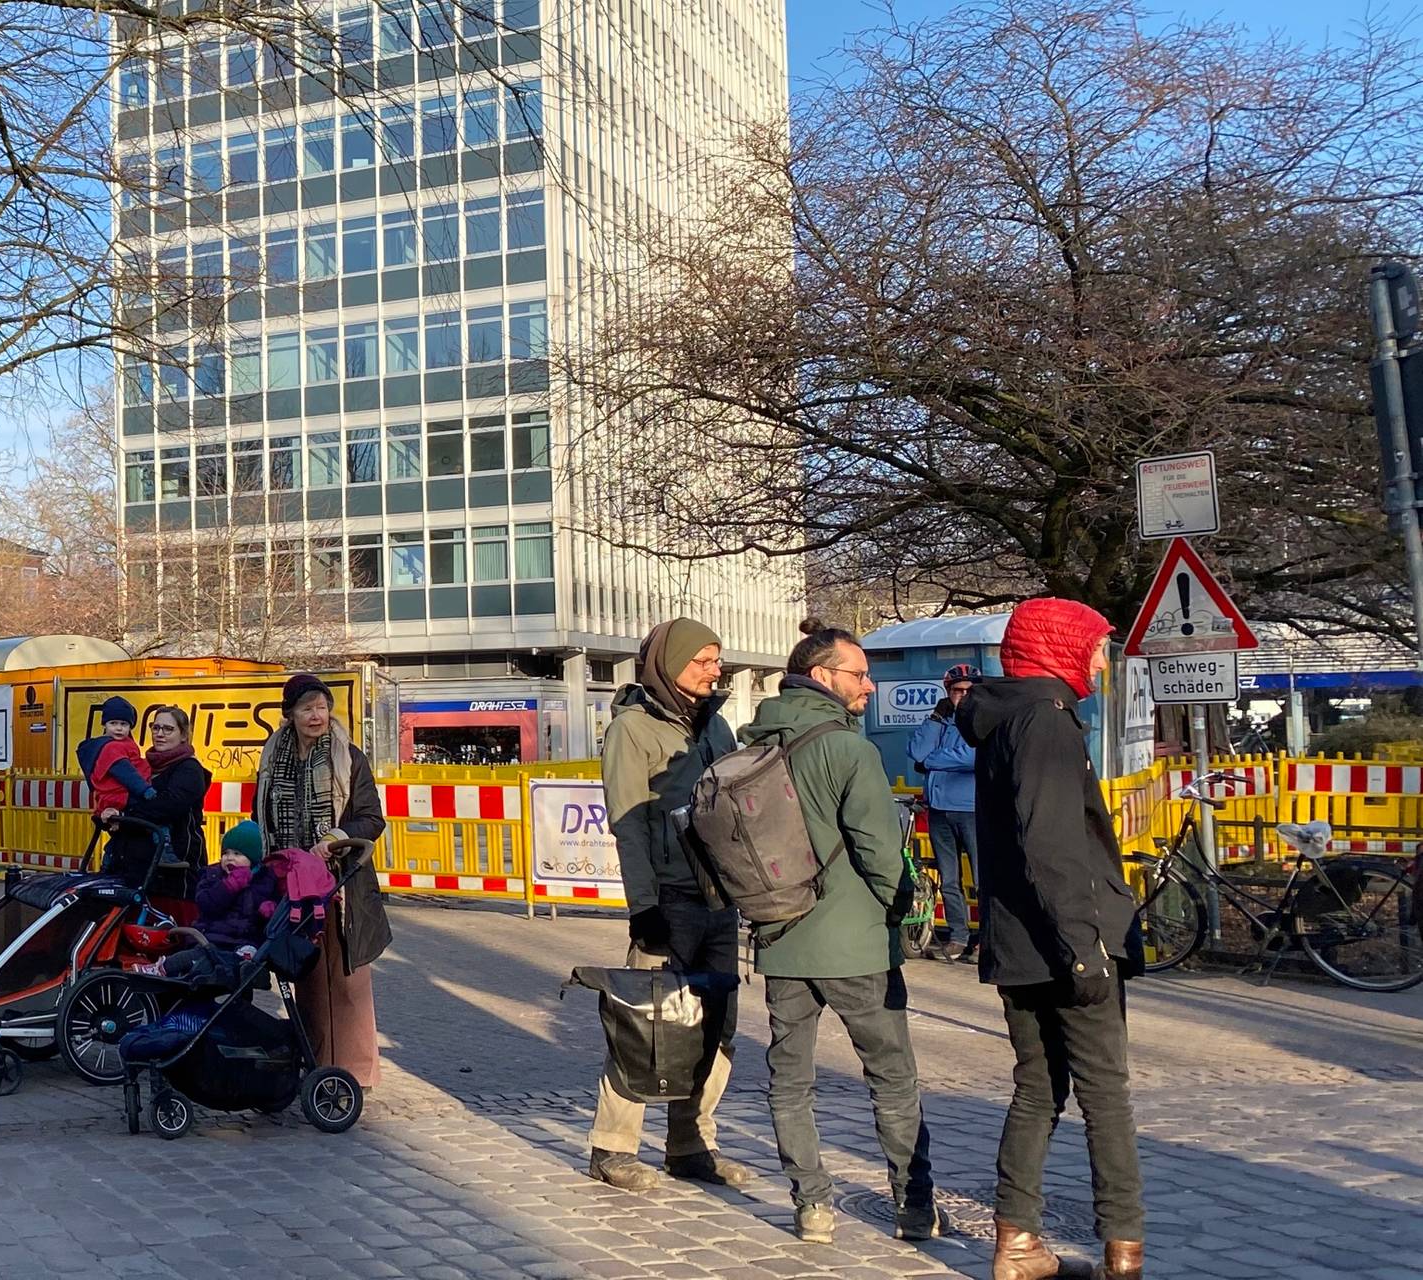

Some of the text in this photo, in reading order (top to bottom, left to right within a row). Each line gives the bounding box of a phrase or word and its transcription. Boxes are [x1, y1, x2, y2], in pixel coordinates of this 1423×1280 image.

[1142, 459, 1207, 474] RETTUNGSWEG
[1158, 661, 1226, 676] Gehweg-
[1163, 680, 1224, 694] schäden
[1238, 676, 1260, 689] EL
[469, 700, 528, 711] DRAHTESEL
[560, 804, 611, 835] DR
